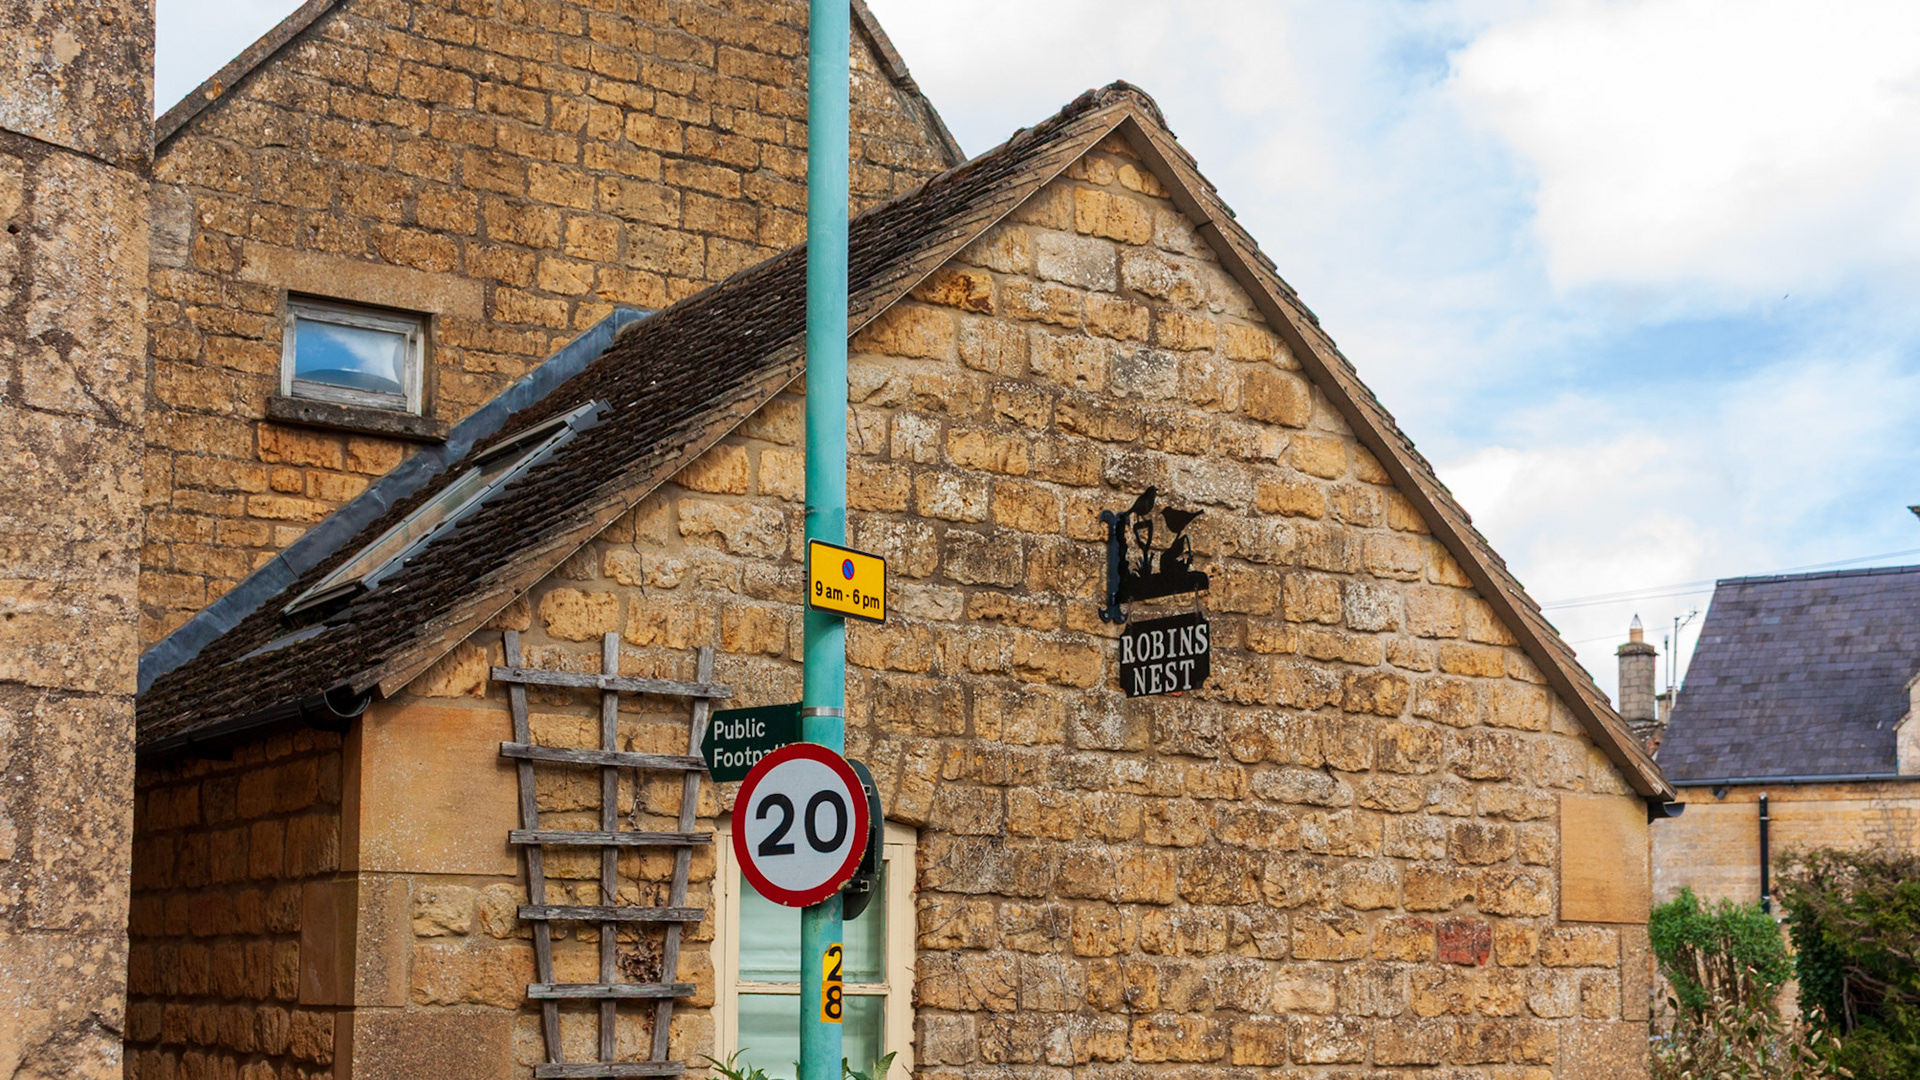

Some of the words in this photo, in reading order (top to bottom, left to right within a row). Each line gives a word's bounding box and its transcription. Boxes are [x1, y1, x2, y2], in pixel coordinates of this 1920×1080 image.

[1121, 623, 1208, 664] ROBINS
[1133, 659, 1195, 696] NEST
[713, 718, 766, 741] Public
[713, 743, 786, 768] Footp
[755, 789, 848, 857] 20
